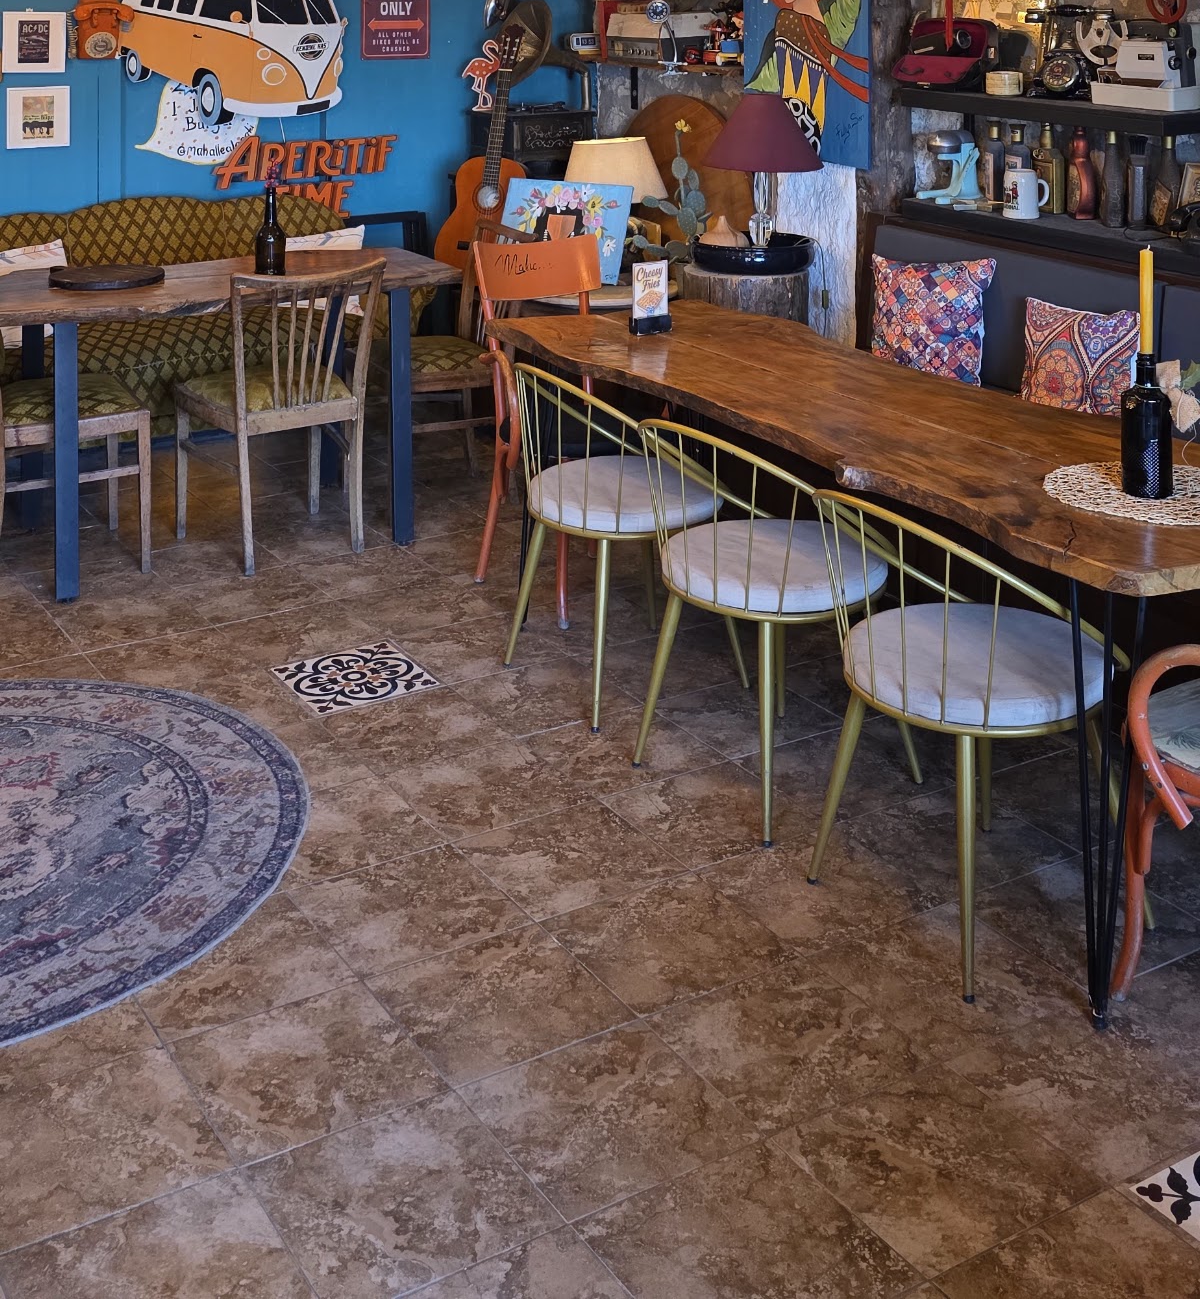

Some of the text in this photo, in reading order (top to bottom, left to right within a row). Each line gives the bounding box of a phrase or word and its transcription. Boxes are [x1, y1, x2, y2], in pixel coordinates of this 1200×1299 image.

[380, 1, 413, 16] ONLY
[636, 266, 663, 282] Cheesy
[642, 279, 661, 292] Fries
